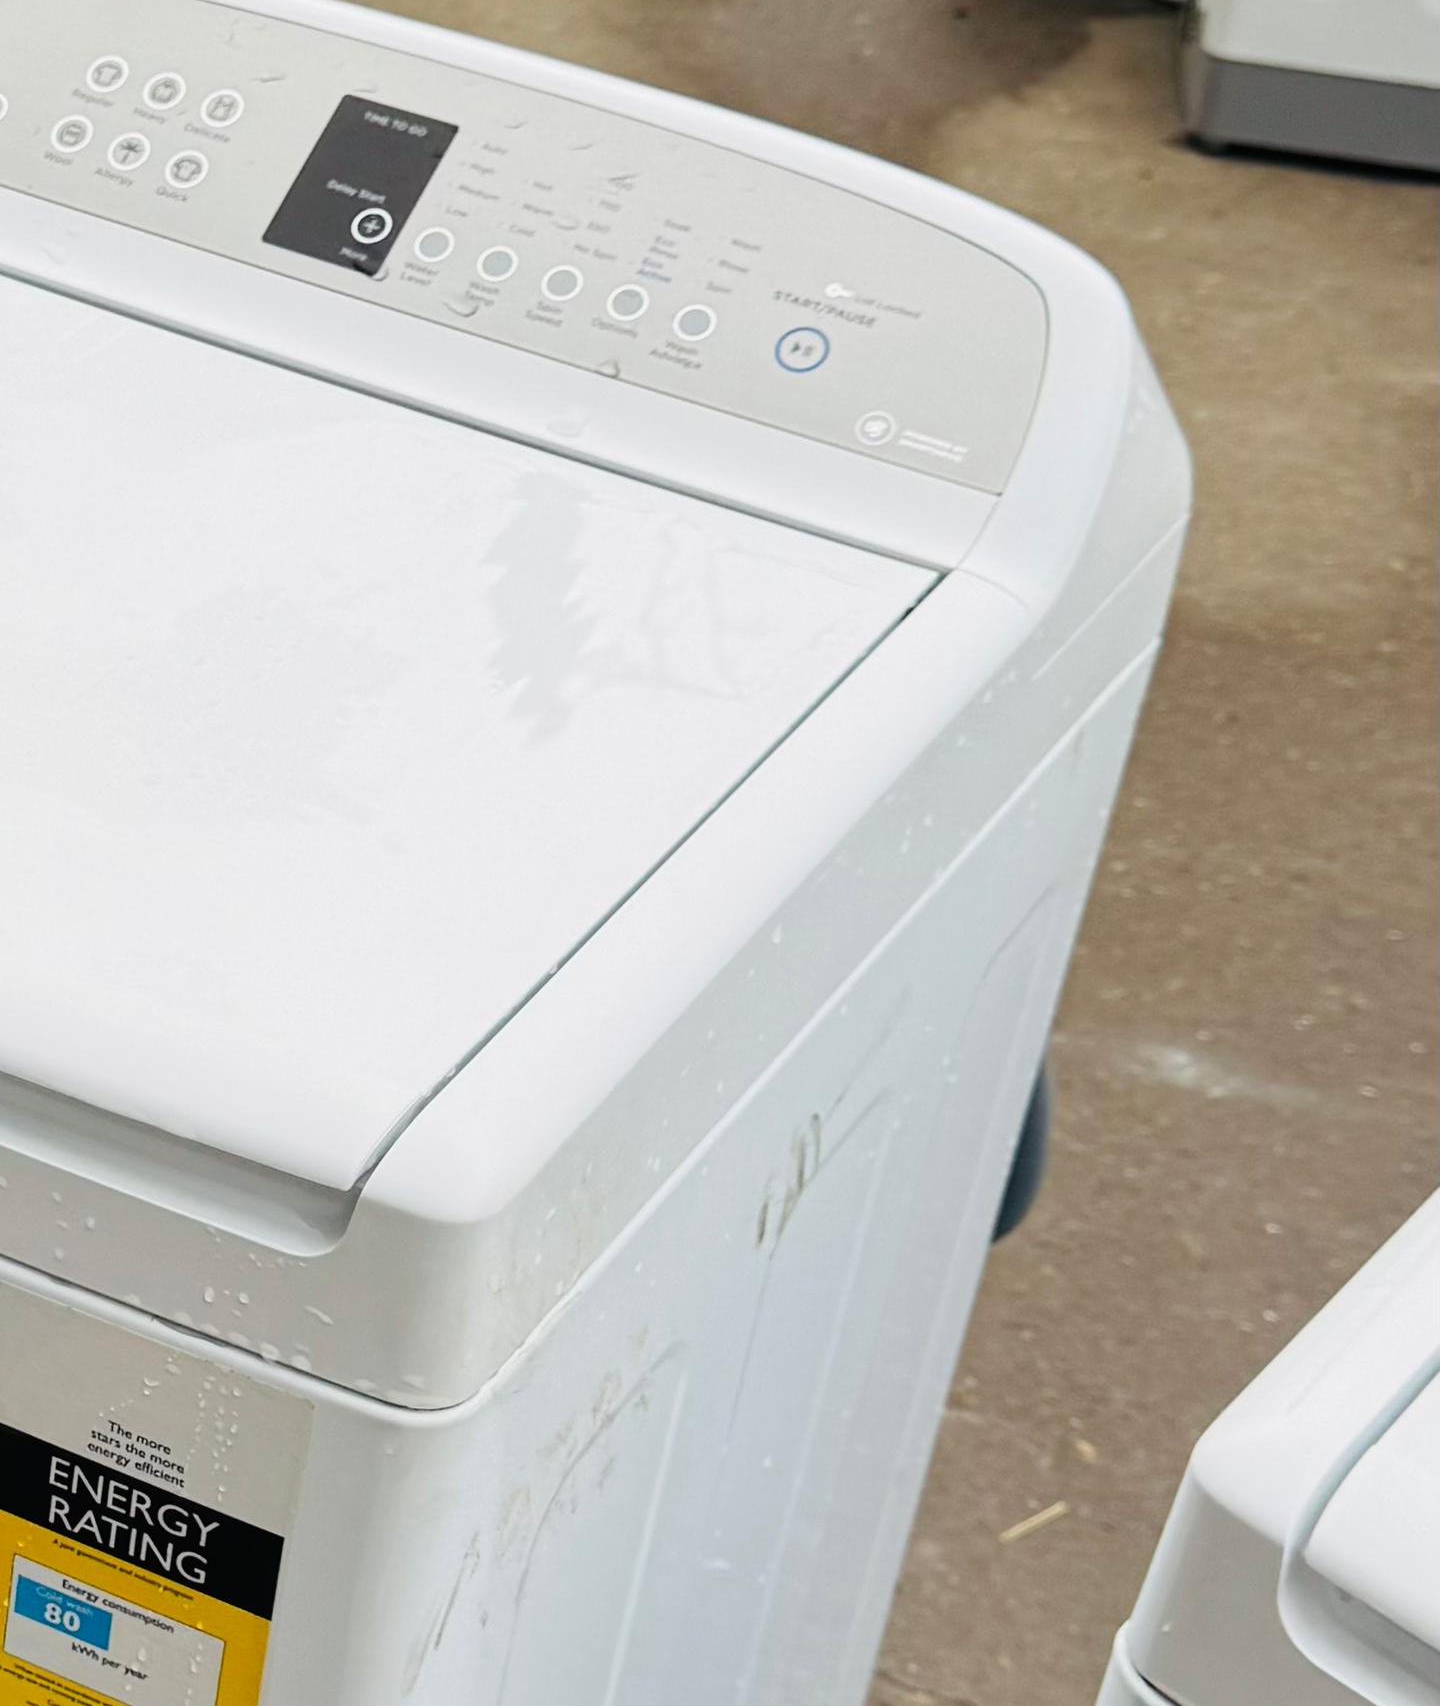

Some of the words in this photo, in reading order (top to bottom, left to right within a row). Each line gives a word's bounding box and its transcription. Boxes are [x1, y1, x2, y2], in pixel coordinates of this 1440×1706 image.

[183, 123, 231, 142] Delicate
[364, 111, 389, 127] TIME
[392, 119, 408, 131] TO
[409, 123, 429, 137] GO
[43, 152, 74, 165] Wool
[95, 168, 134, 186] Allergy
[326, 179, 357, 197] Delay
[358, 190, 386, 204] Start
[340, 247, 367, 262] More
[773, 290, 876, 327] START/PAUSE
[91, 1430, 121, 1448] stars
[125, 1444, 145, 1458] the
[150, 1454, 184, 1474] more
[108, 1420, 132, 1439] The
[136, 1435, 171, 1455] more
[87, 1443, 130, 1467] energy
[135, 1462, 184, 1488] efficient
[49, 1456, 220, 1547] ENERGY
[49, 1495, 207, 1583] RATING
[36, 1586, 62, 1604] Cold
[62, 1579, 99, 1603] Energy
[102, 1598, 174, 1633] consumption
[44, 1602, 81, 1635] 80
[72, 1642, 99, 1660] kWh
[101, 1655, 120, 1672] per
[124, 1666, 149, 1682] year
